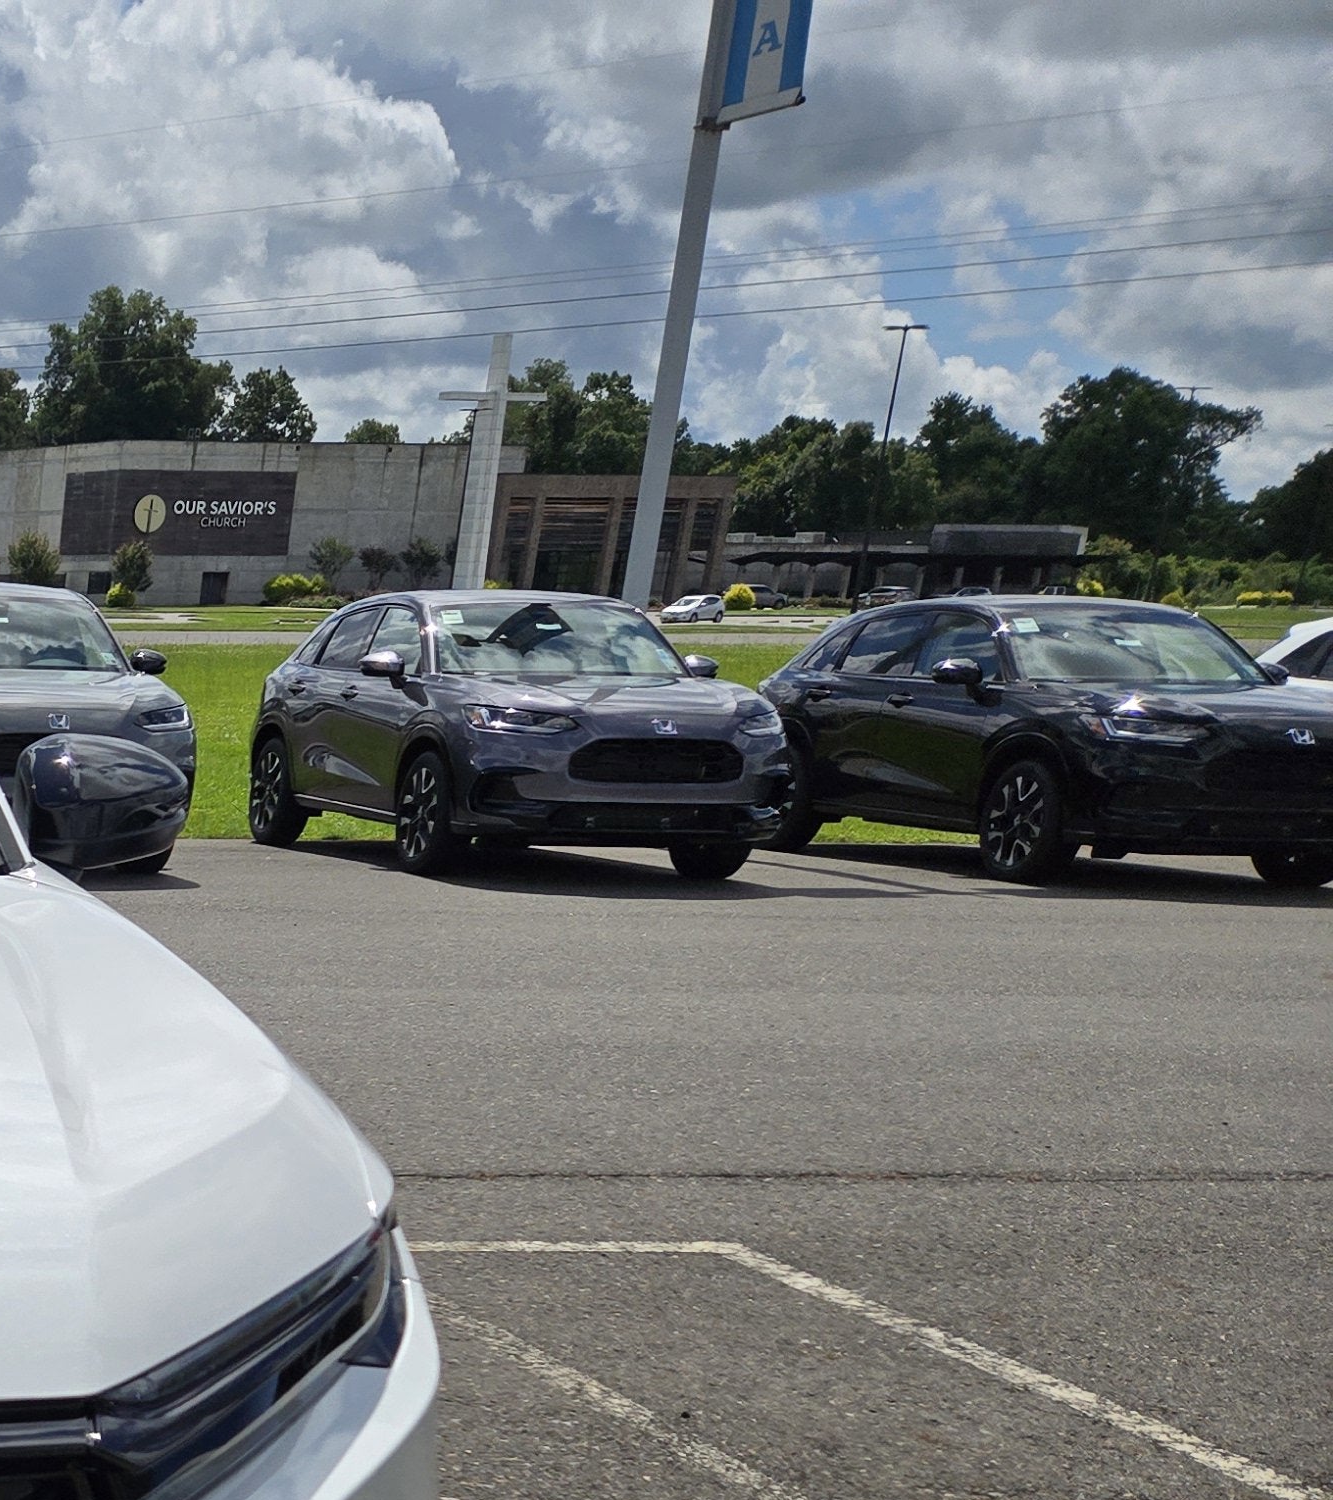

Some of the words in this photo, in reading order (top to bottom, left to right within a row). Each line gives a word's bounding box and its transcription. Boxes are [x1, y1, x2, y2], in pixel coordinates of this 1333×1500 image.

[752, 20, 783, 56] A
[173, 499, 207, 515] OUR
[209, 500, 278, 516] SAVIOR'S
[200, 516, 247, 528] CHURCH
